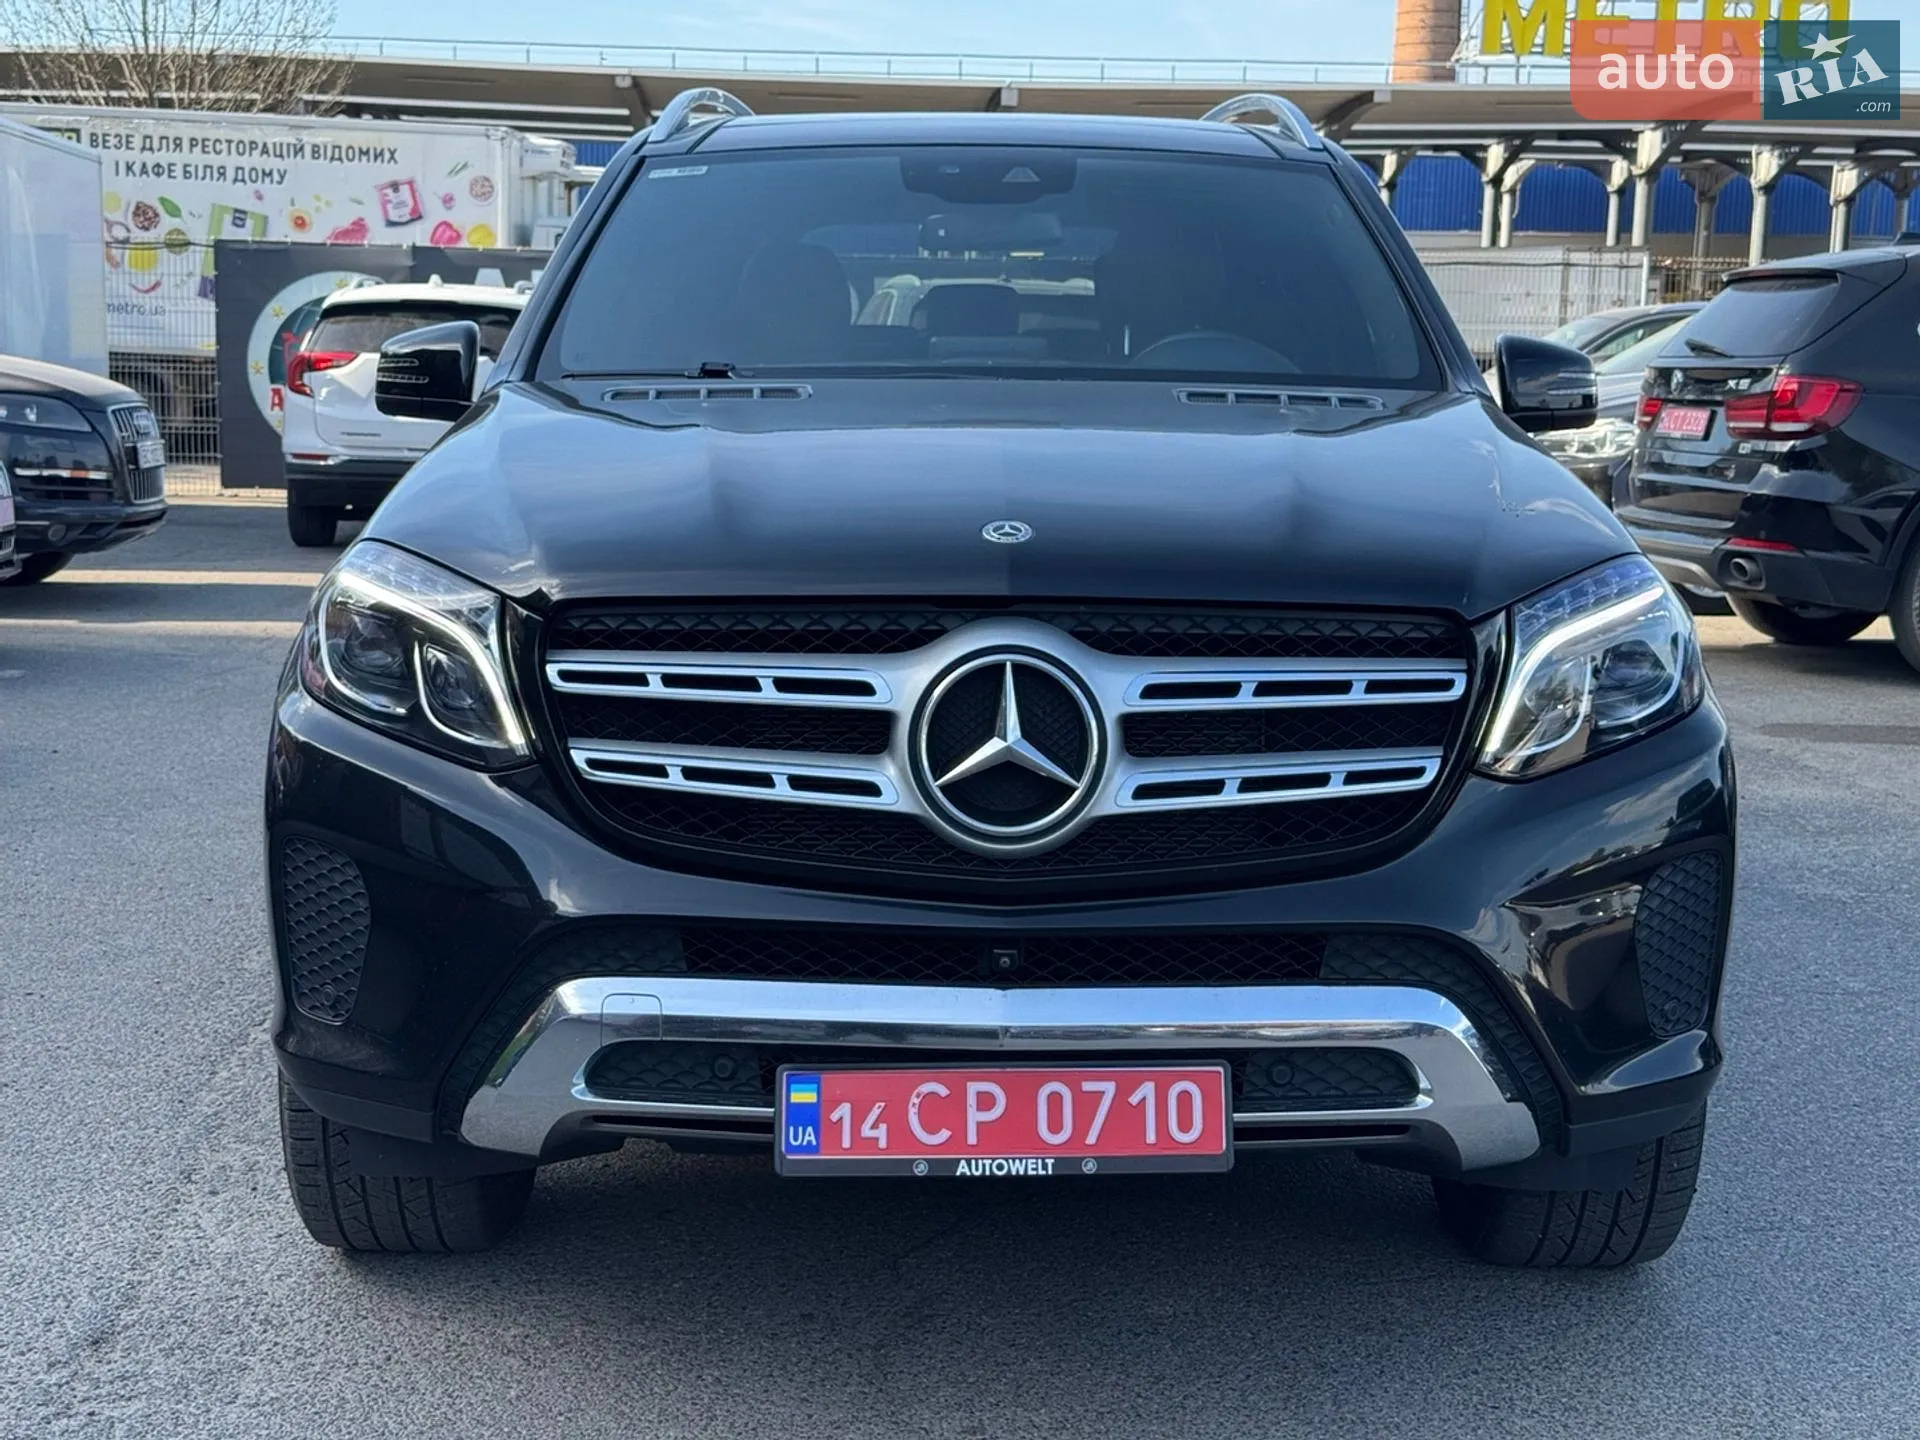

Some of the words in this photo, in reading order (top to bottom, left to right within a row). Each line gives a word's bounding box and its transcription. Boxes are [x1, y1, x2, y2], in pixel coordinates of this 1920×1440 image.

[89, 132, 135, 150] ВЕЗЕ
[140, 135, 183, 154] ДЛЯ
[189, 137, 305, 161] РЕСТОРАЦІЙ
[311, 143, 399, 165] ВІДОМИХ
[125, 161, 177, 179] КАФЕ
[182, 163, 227, 182] БІЛЯ
[232, 166, 288, 186] ДОМУ
[829, 1102, 887, 1149] 14
[908, 1081, 1007, 1146] CP
[1038, 1080, 1203, 1145] 0710
[789, 1126, 817, 1146] UA
[956, 1159, 1055, 1176] AUTOWELT
